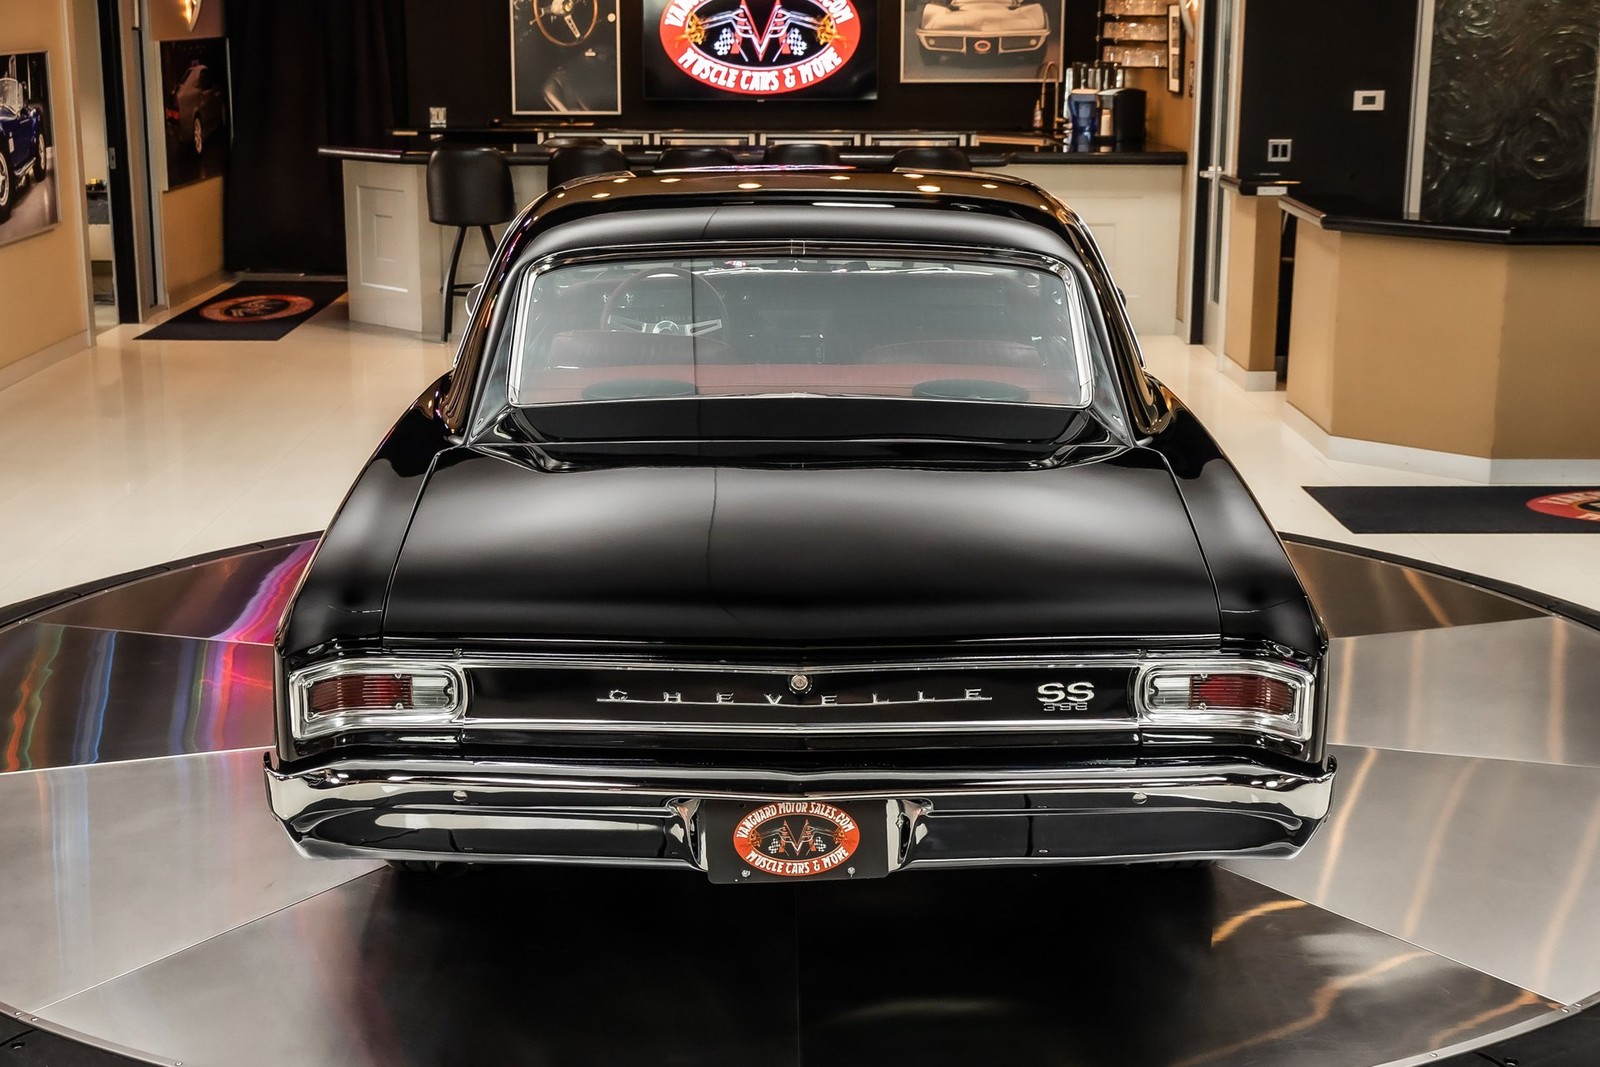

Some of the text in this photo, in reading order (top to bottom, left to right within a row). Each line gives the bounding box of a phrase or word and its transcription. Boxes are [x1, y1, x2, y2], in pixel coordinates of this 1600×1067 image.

[678, 46, 842, 91] MUSCLE CARS & MORE
[598, 688, 992, 707] CHEVELLE
[1037, 682, 1095, 702] SS
[736, 802, 855, 838] VANGUARD MOTOR SALES.COM
[746, 846, 849, 874] MUSCLE CARS & MORE
